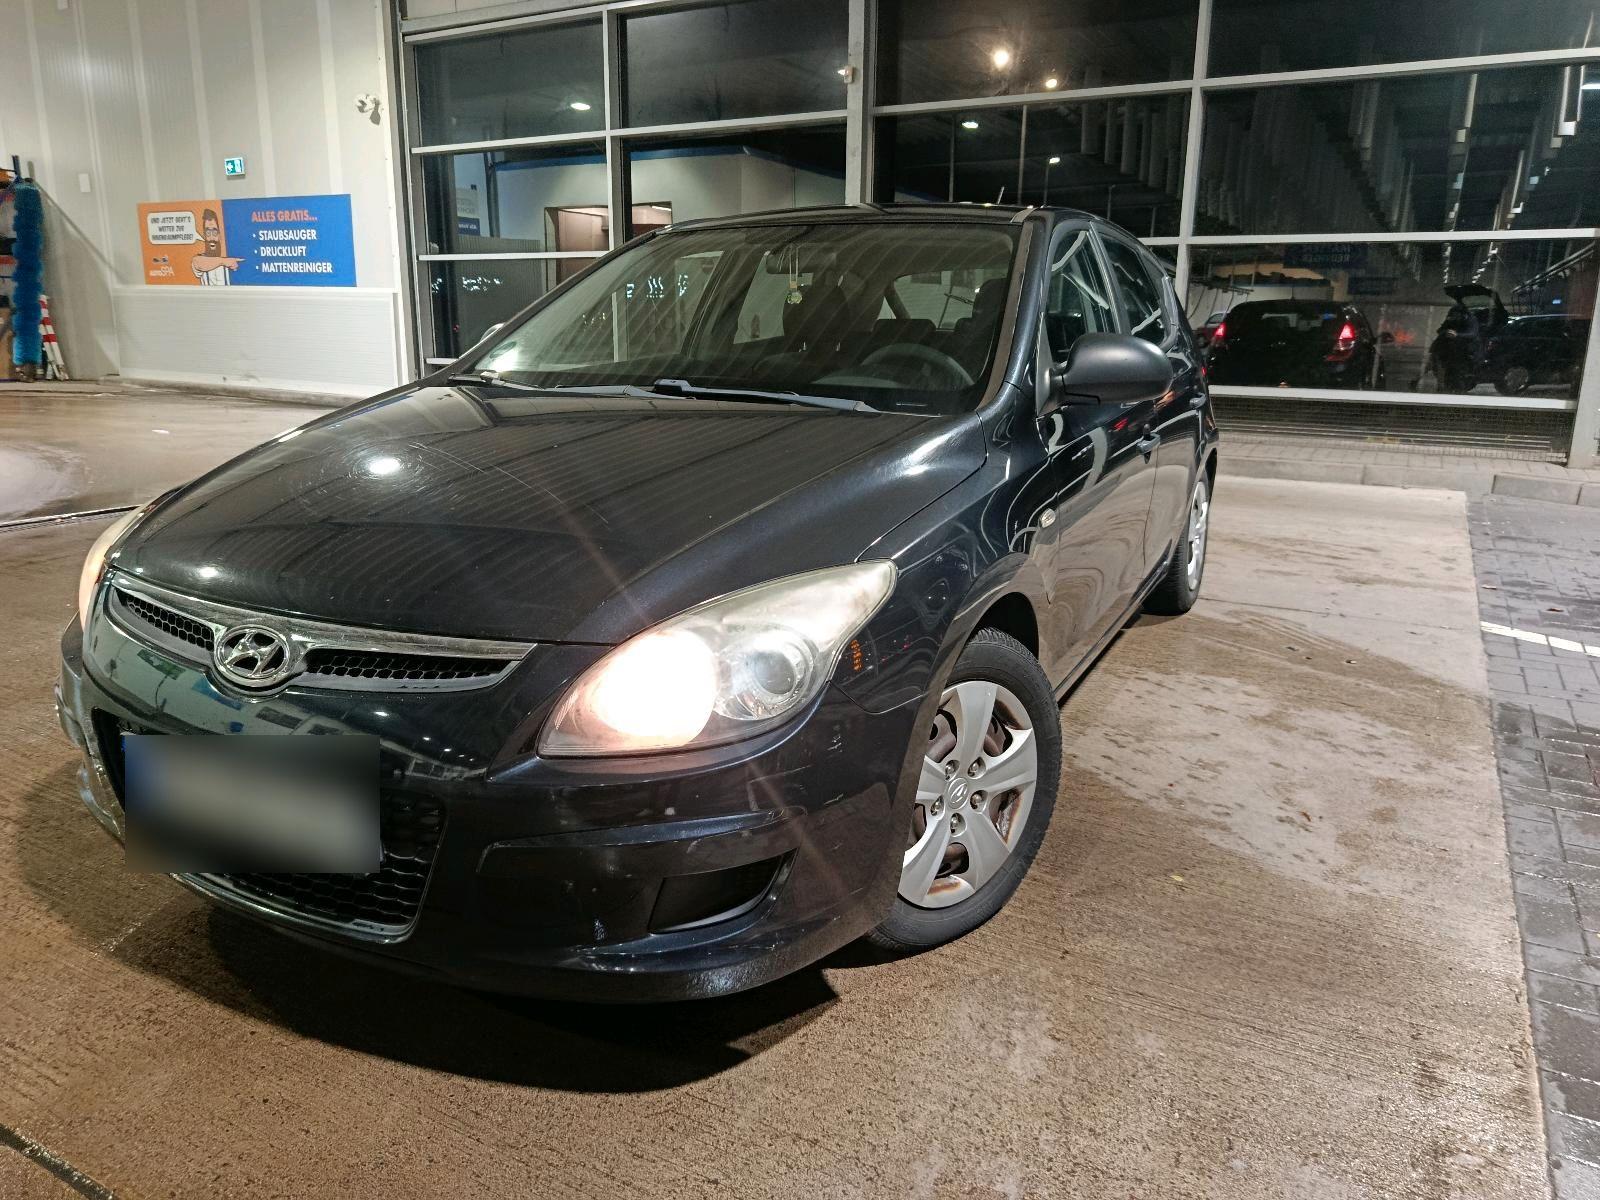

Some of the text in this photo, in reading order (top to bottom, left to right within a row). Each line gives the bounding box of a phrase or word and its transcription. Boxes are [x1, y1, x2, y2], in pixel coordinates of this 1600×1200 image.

[251, 209, 318, 223] ALLES GRATIS...
[258, 229, 317, 241] STAUBSAUGER
[260, 246, 307, 257] DRUCKLUFT
[262, 262, 333, 273] MATTENREINIGER
